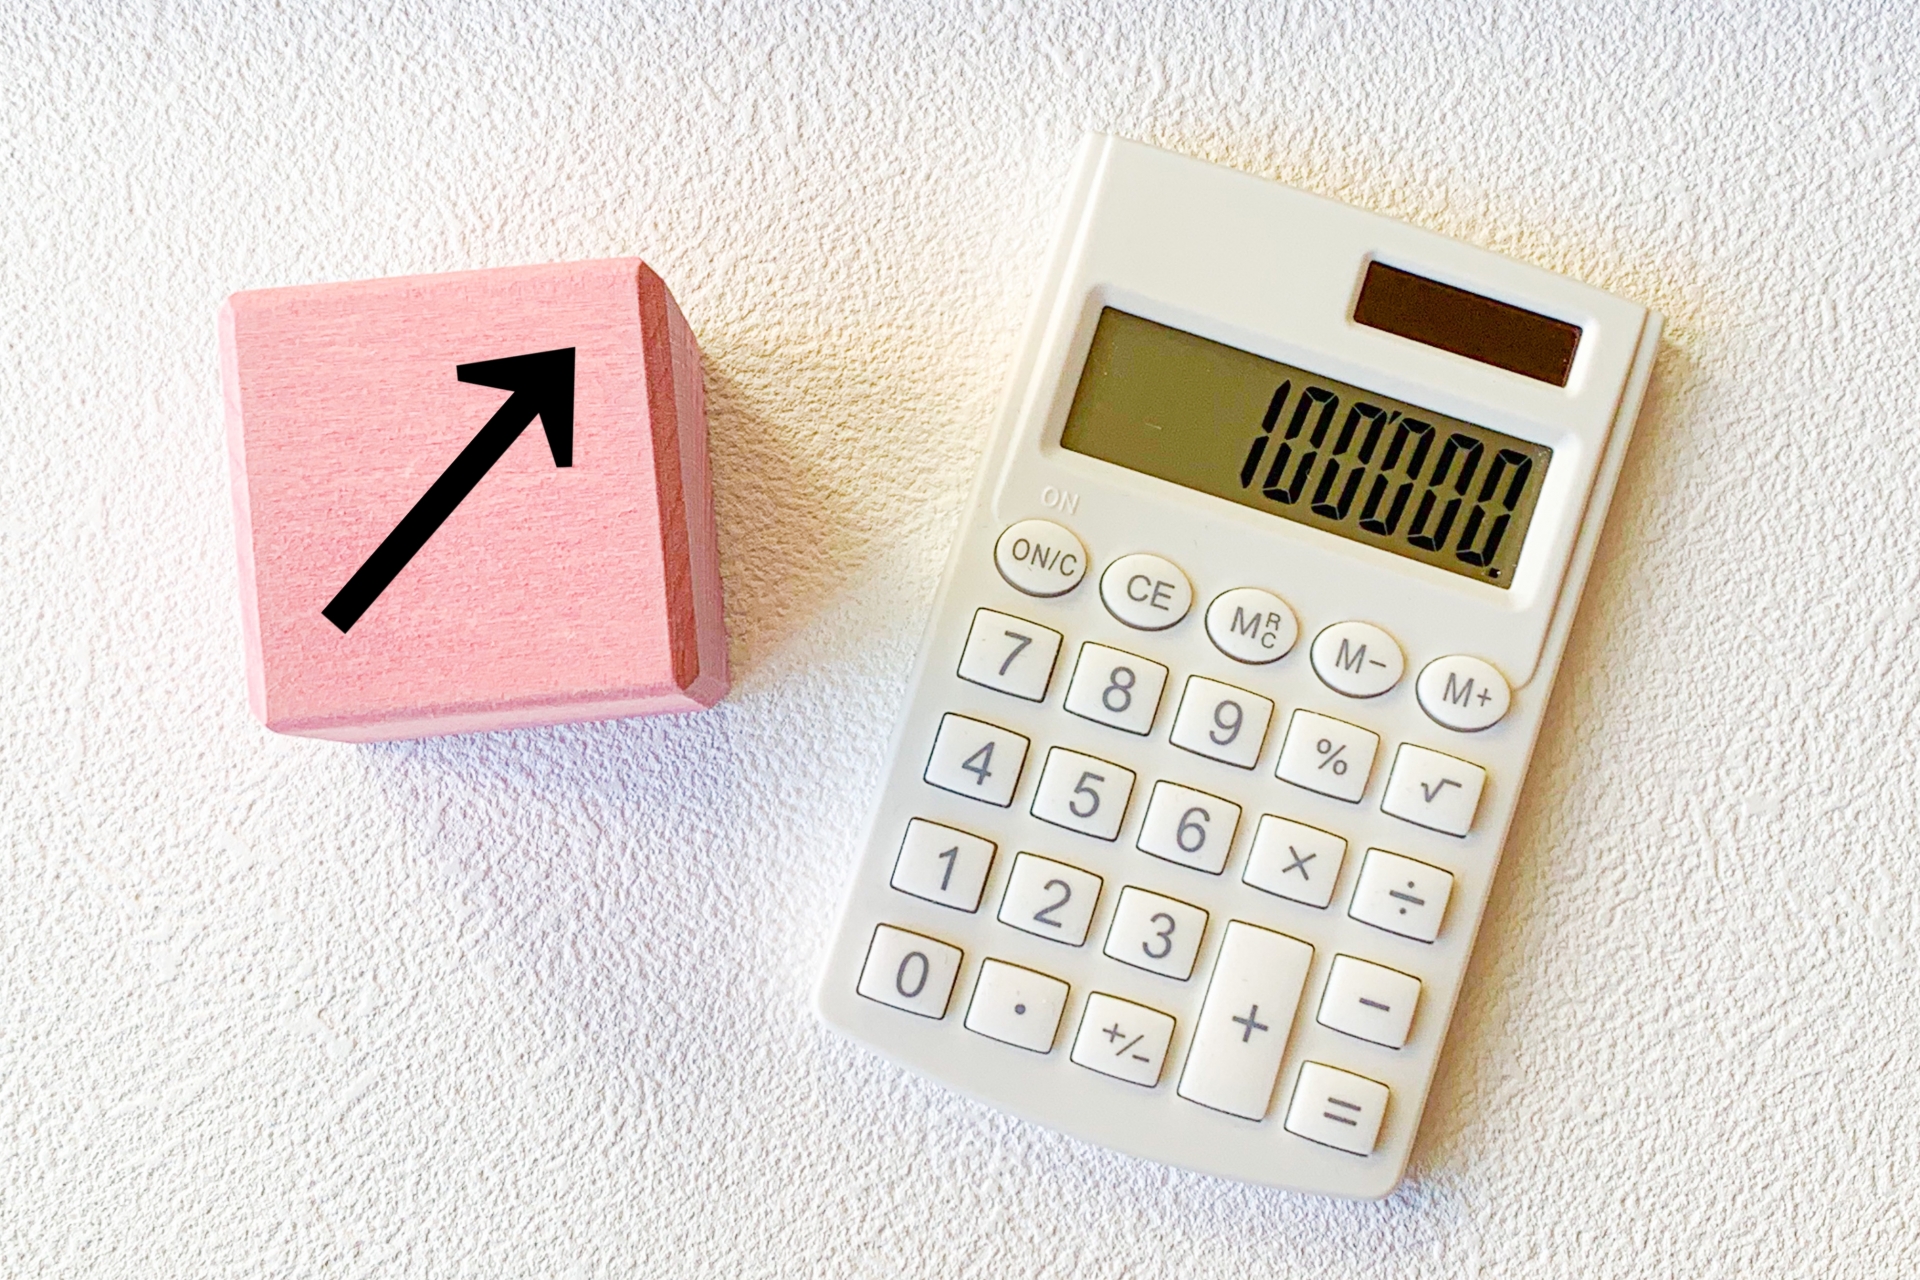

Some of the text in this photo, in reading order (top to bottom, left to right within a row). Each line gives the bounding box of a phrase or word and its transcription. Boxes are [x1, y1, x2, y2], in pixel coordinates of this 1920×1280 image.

[1041, 485, 1080, 515] ON
[1012, 538, 1078, 577] ON/C
[1127, 575, 1175, 611] CE
[999, 630, 1033, 676] 7
[1102, 666, 1136, 713] 8
[1443, 672, 1492, 707] M+
[1209, 700, 1243, 746] 9
[962, 742, 995, 785] 4
[1317, 739, 1347, 775] %
[1069, 771, 1105, 818] 5
[1177, 807, 1210, 853] 6
[939, 846, 959, 891] 1
[1033, 879, 1071, 928] 2
[1142, 913, 1176, 959] 3
[896, 951, 929, 998] 0
